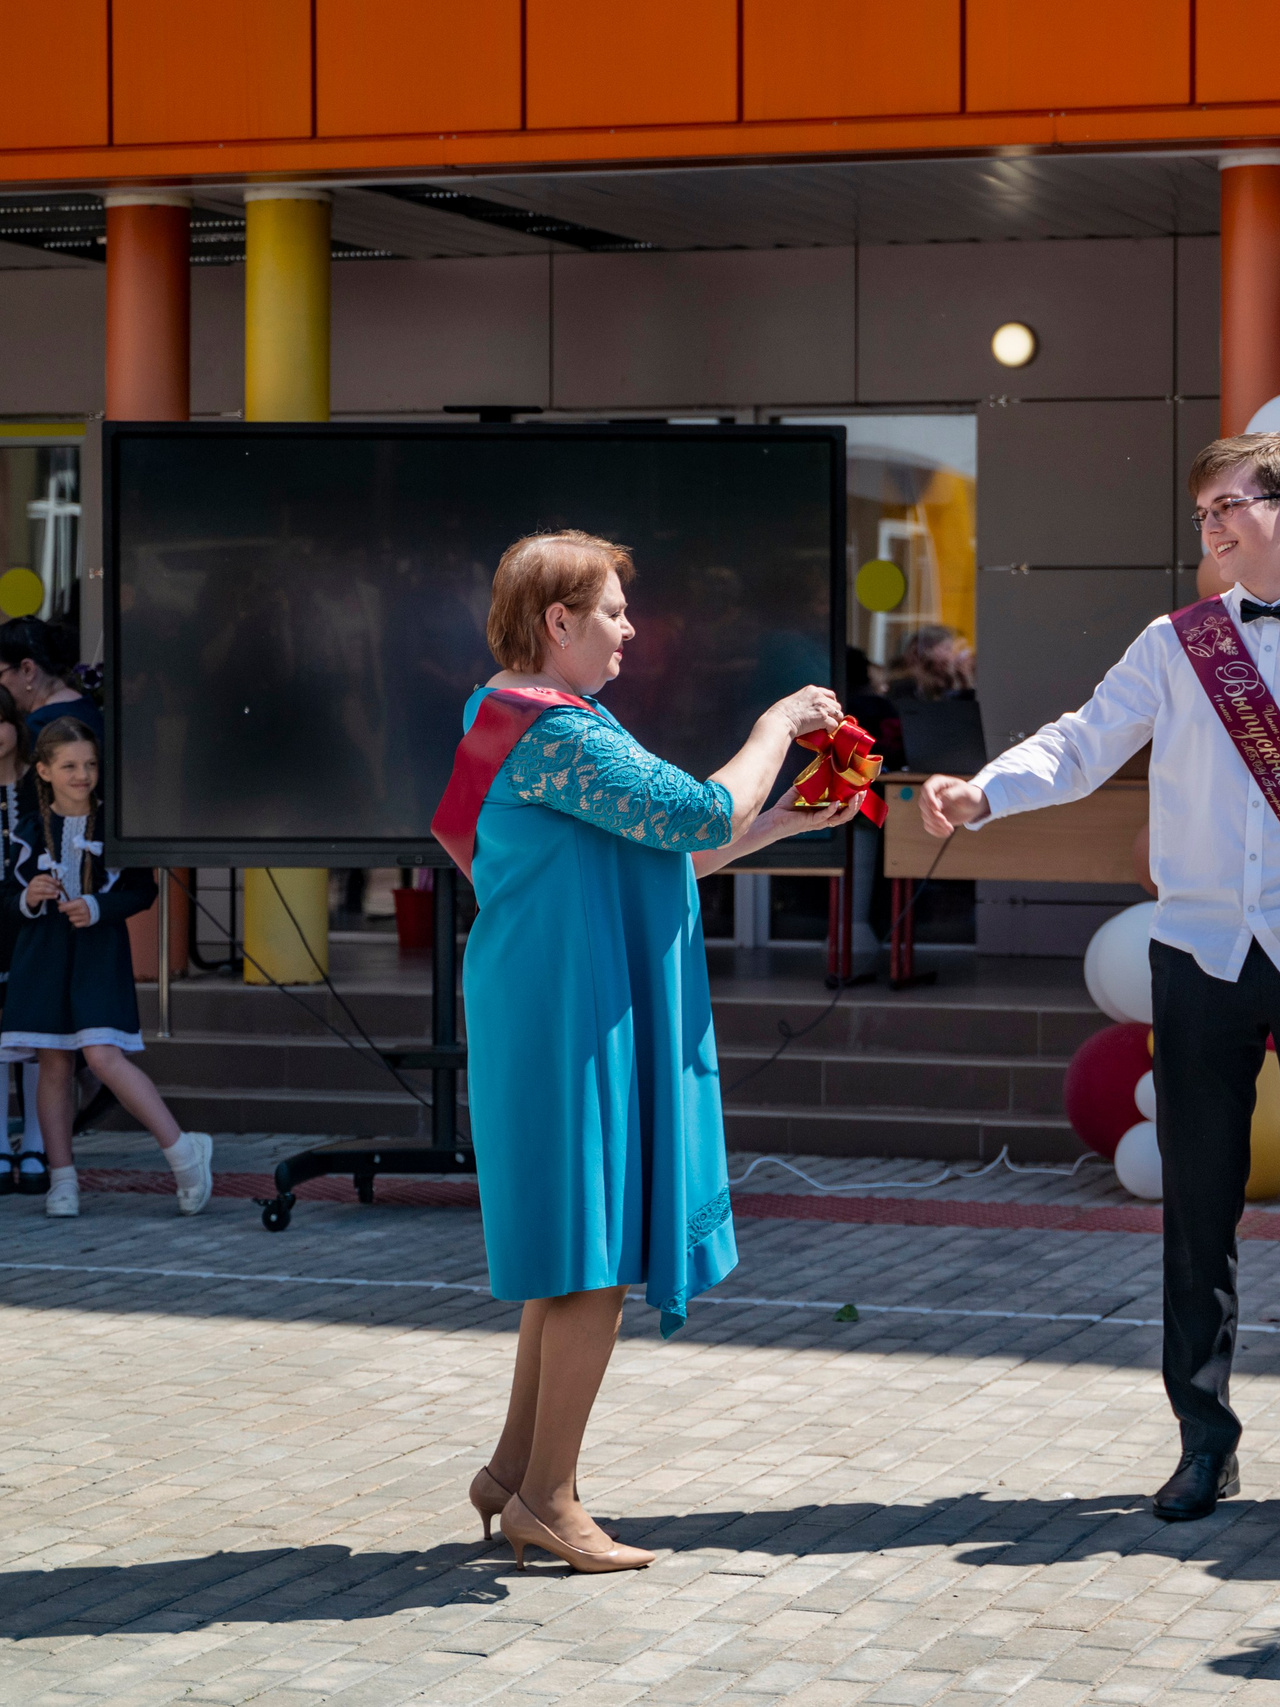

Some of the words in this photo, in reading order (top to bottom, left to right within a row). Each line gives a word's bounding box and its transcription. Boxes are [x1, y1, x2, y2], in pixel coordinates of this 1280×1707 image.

[1213, 692, 1225, 704] 11
[1218, 702, 1233, 723] класс
[1240, 741, 1269, 776] МБОУ
